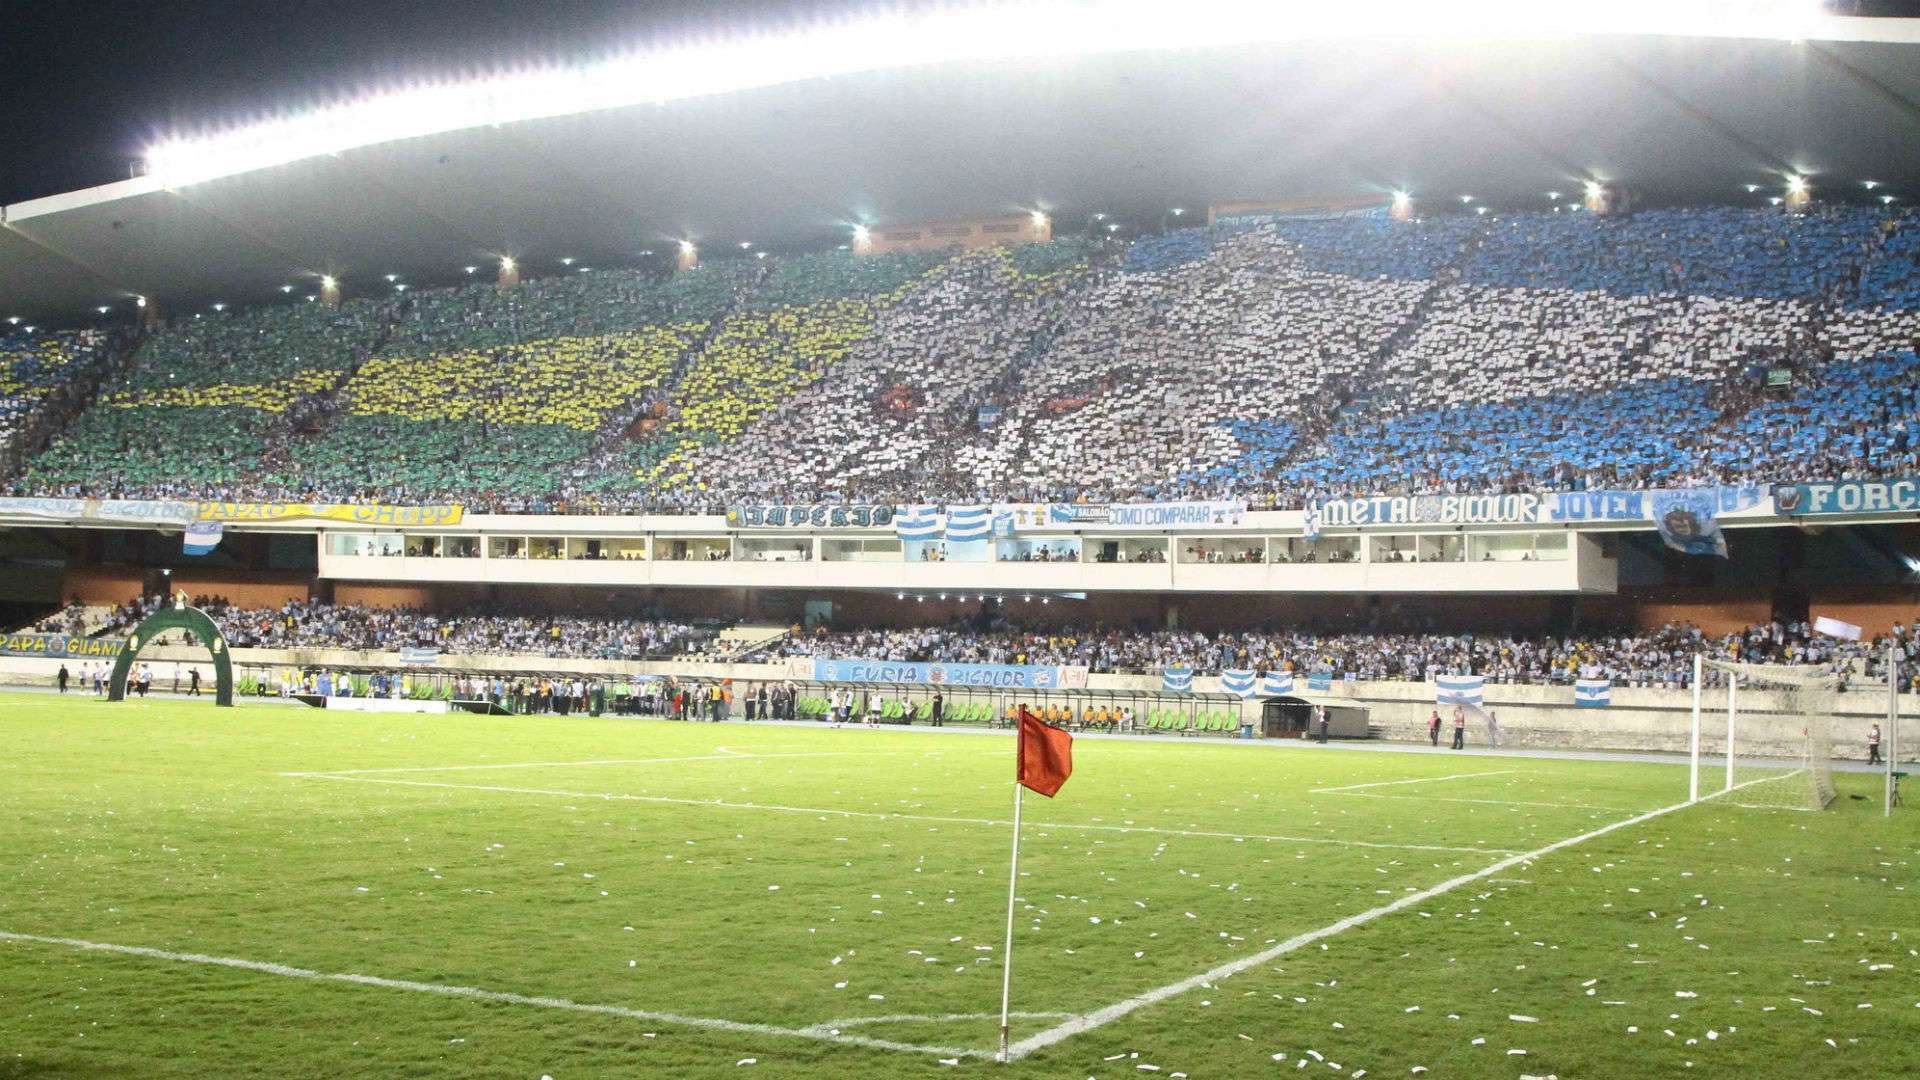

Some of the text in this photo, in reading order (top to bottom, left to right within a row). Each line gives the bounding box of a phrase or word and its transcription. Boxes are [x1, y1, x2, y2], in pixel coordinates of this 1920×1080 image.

[1109, 505, 1210, 526] COMO COMPARAR
[1323, 493, 1538, 525] METAL BICOLOR
[1550, 490, 1645, 521] JOVEM
[0, 634, 46, 652] PAPA
[953, 667, 1026, 687] BICOLOR
